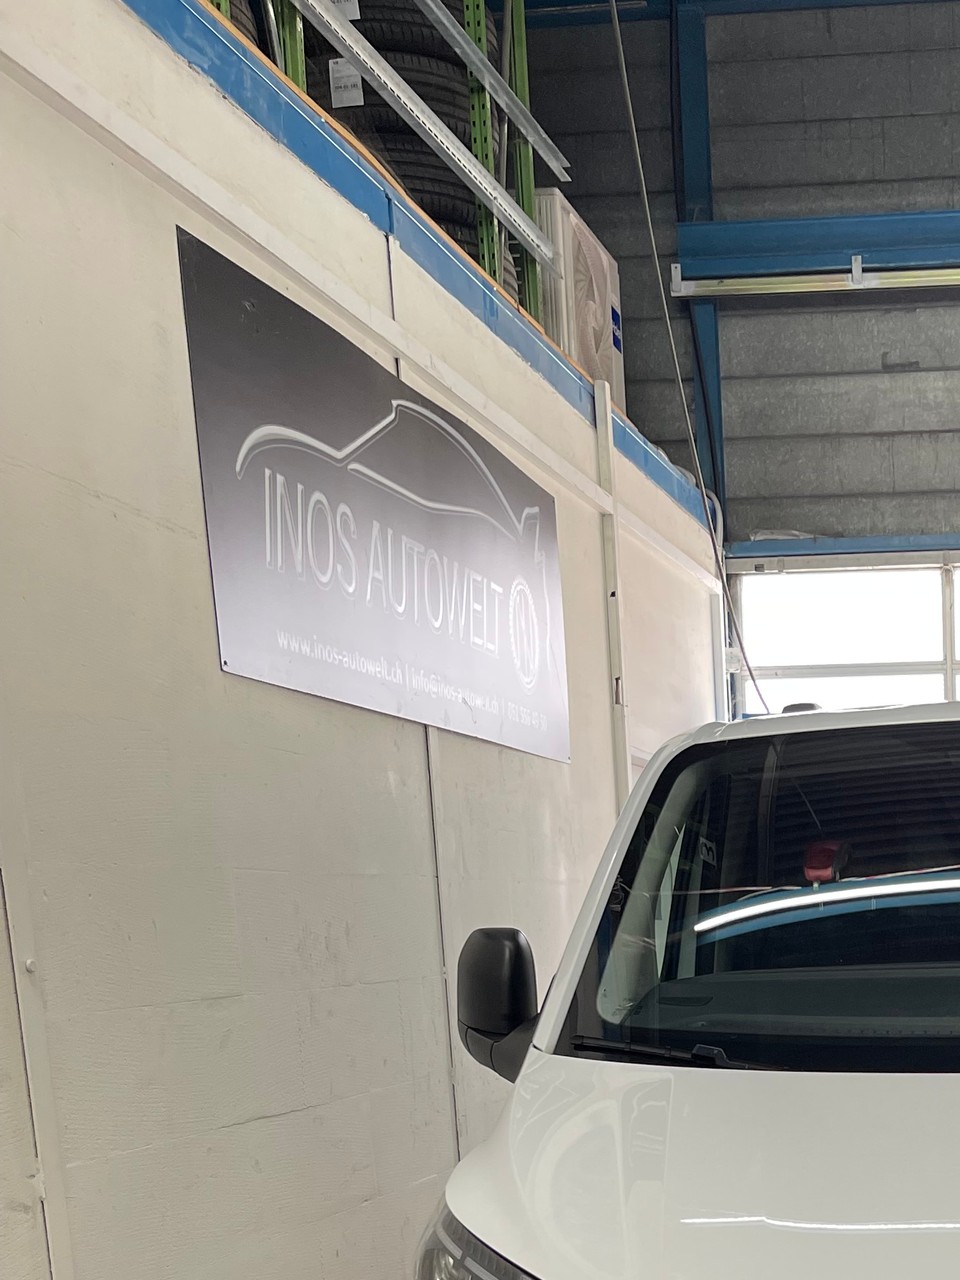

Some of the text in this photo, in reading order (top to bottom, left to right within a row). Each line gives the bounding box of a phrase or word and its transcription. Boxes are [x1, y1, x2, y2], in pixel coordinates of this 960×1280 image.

[264, 467, 503, 656] INOS AUTOWELT
[276, 629, 403, 685] www.inos-autowelt.ch
